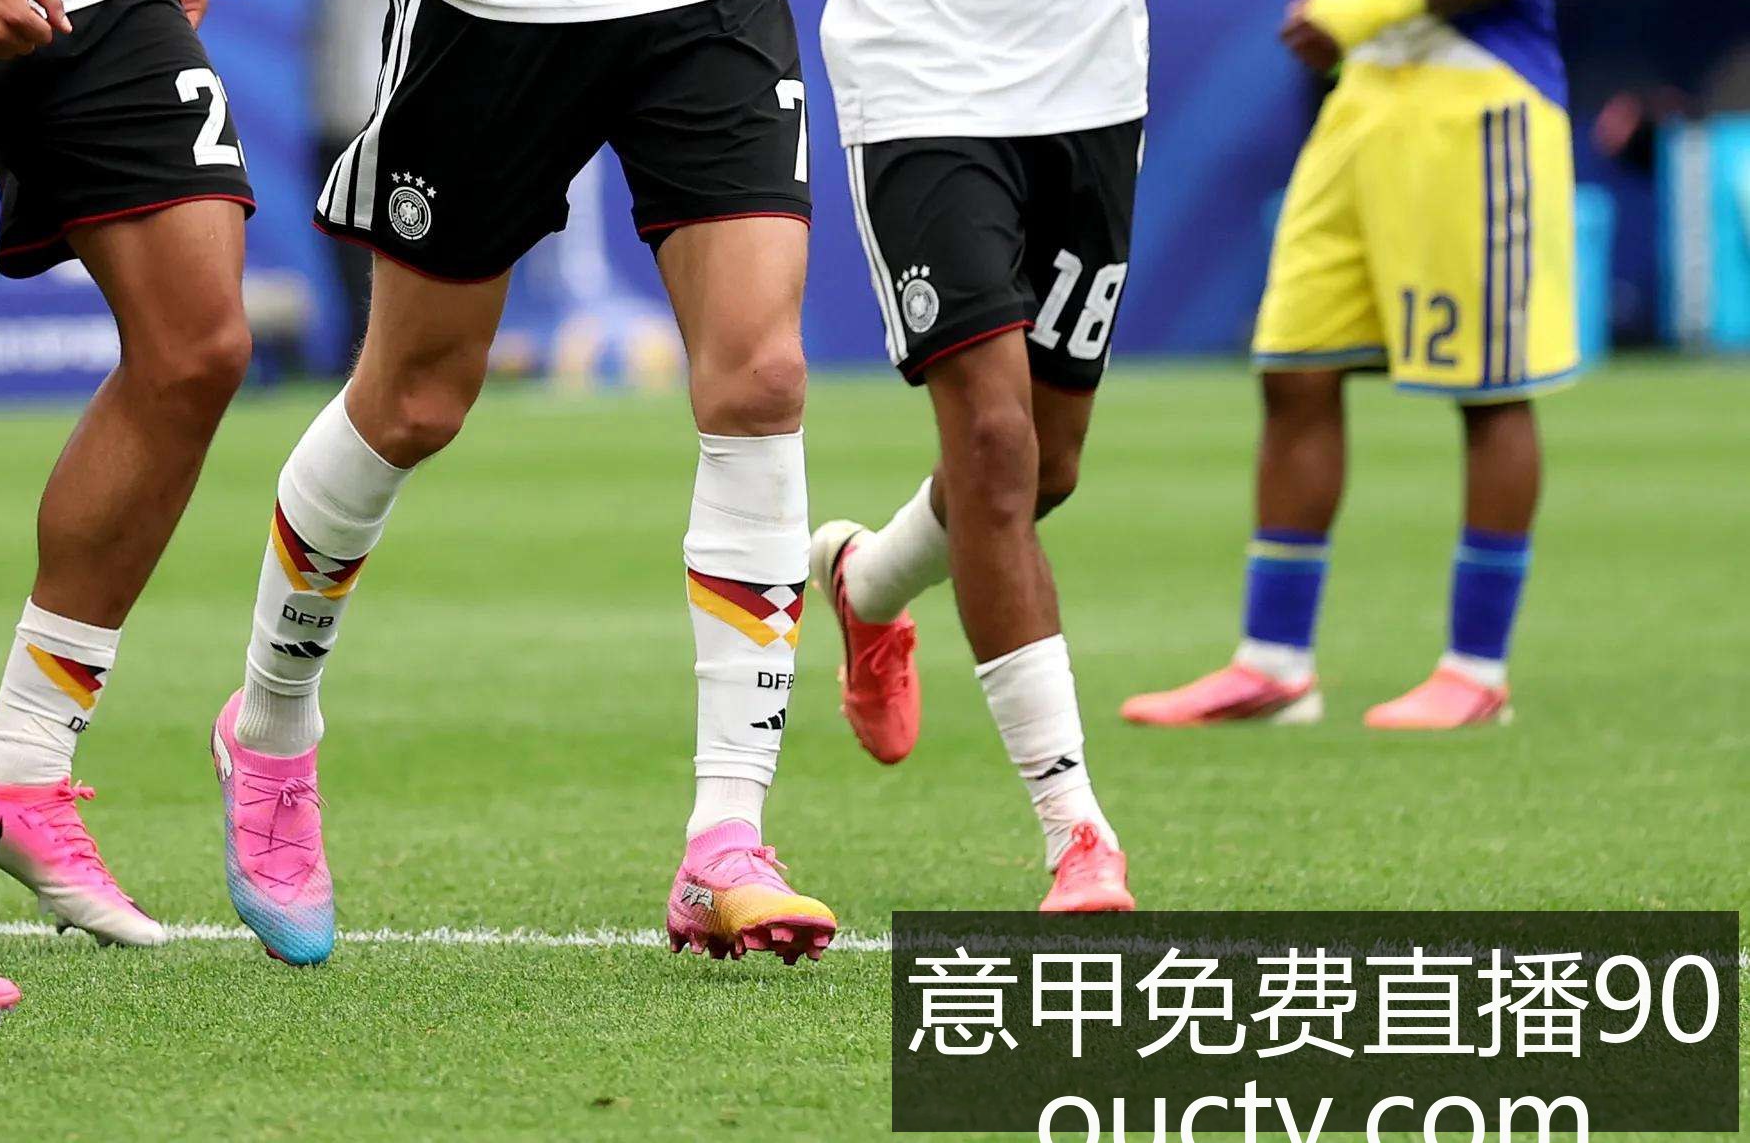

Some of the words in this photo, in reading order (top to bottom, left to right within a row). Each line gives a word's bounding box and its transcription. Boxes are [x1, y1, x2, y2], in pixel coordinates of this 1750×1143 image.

[175, 67, 248, 172] 2
[774, 79, 808, 184] 7
[1027, 248, 1128, 360] 18
[1399, 286, 1458, 367] 12
[282, 603, 335, 628] DFB
